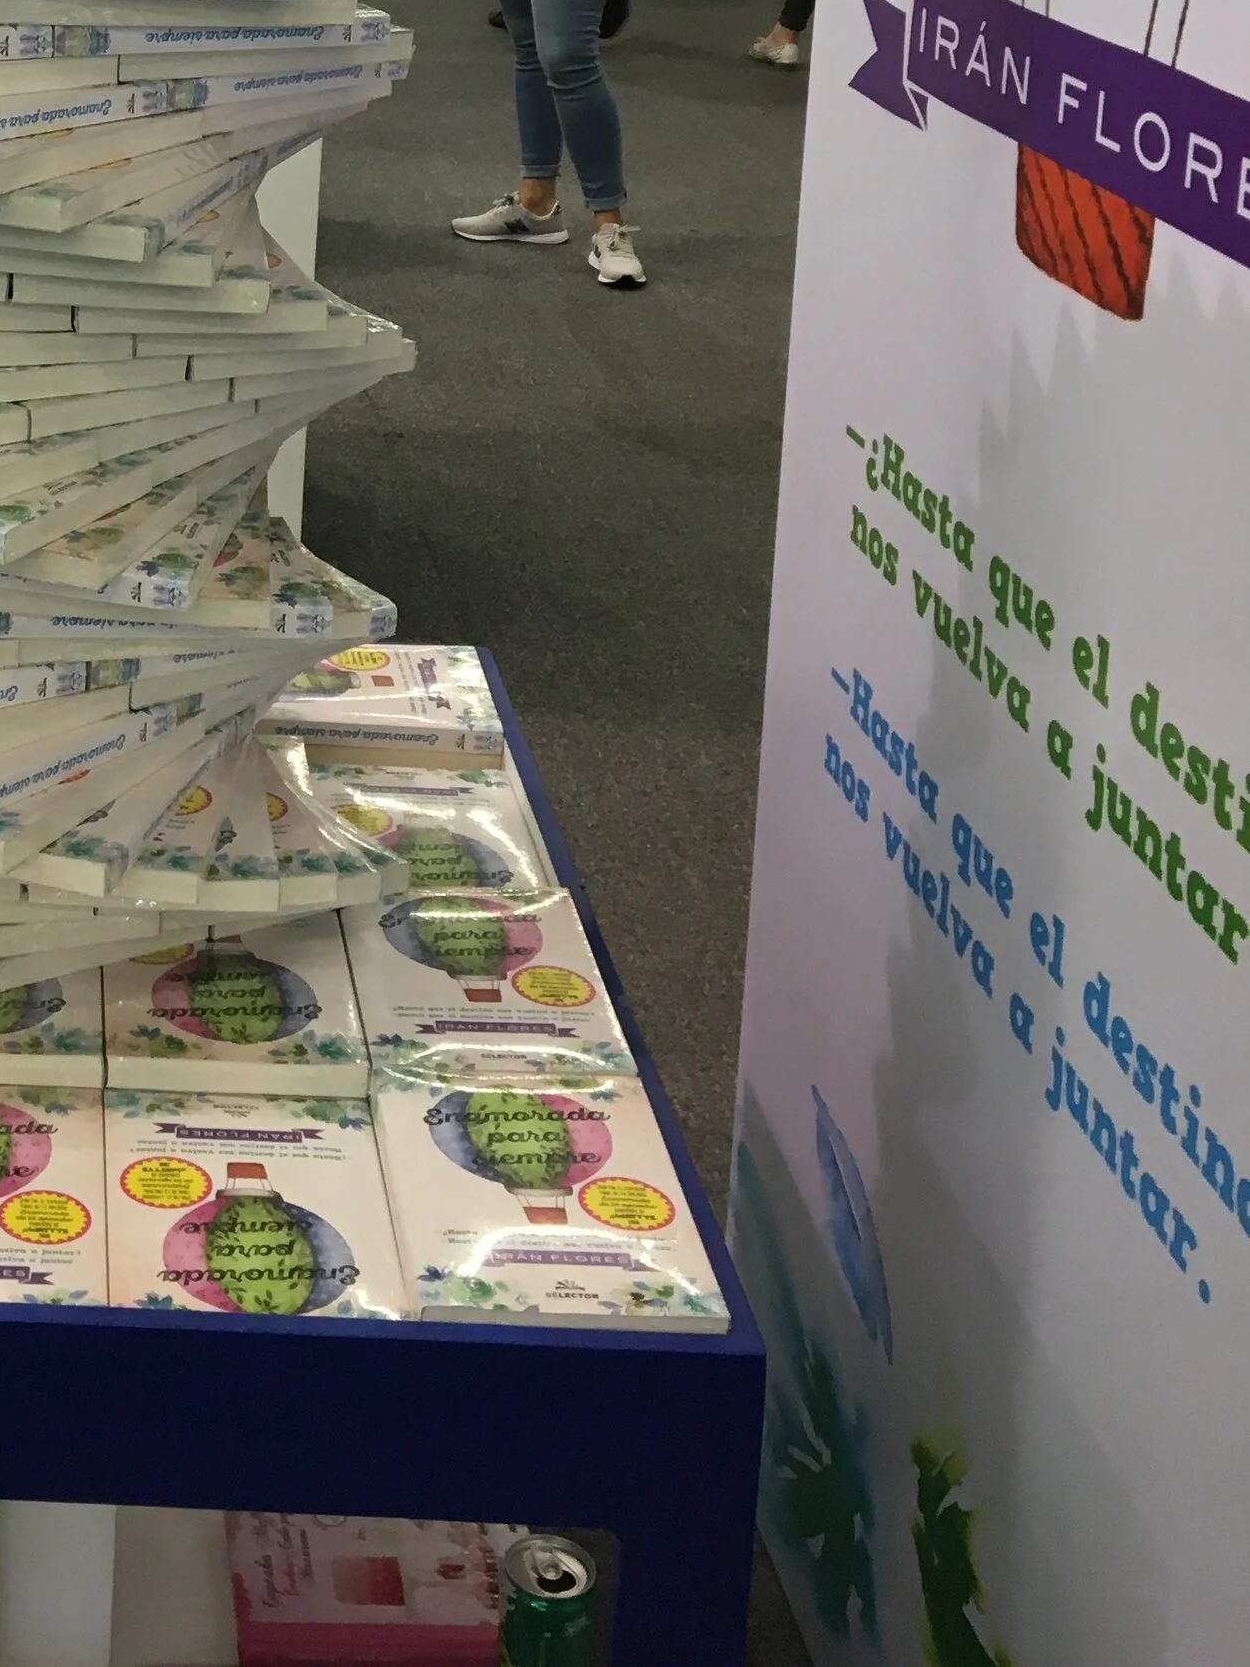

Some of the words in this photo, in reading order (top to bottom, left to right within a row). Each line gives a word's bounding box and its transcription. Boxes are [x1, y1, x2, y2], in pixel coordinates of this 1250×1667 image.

[204, 27, 241, 41] para
[920, 7, 1031, 106] IRÁN
[10, 109, 40, 126] para
[989, 555, 1056, 652] que
[1073, 634, 1111, 709] el
[850, 505, 899, 586] nos
[912, 569, 1030, 733] vuelva
[1047, 719, 1073, 780] a
[1086, 742, 1250, 965] juntar
[824, 733, 869, 823] nos
[883, 812, 994, 999] vuelva
[1009, 992, 1034, 1056] a
[952, 813, 1014, 920] que
[1029, 910, 1066, 989] el
[424, 1108, 611, 1125] Enamorada
[486, 1131, 567, 1146] para
[215, 1241, 295, 1258] para
[550, 1254, 629, 1264] FLORES
[156, 1265, 361, 1286] Enamorada
